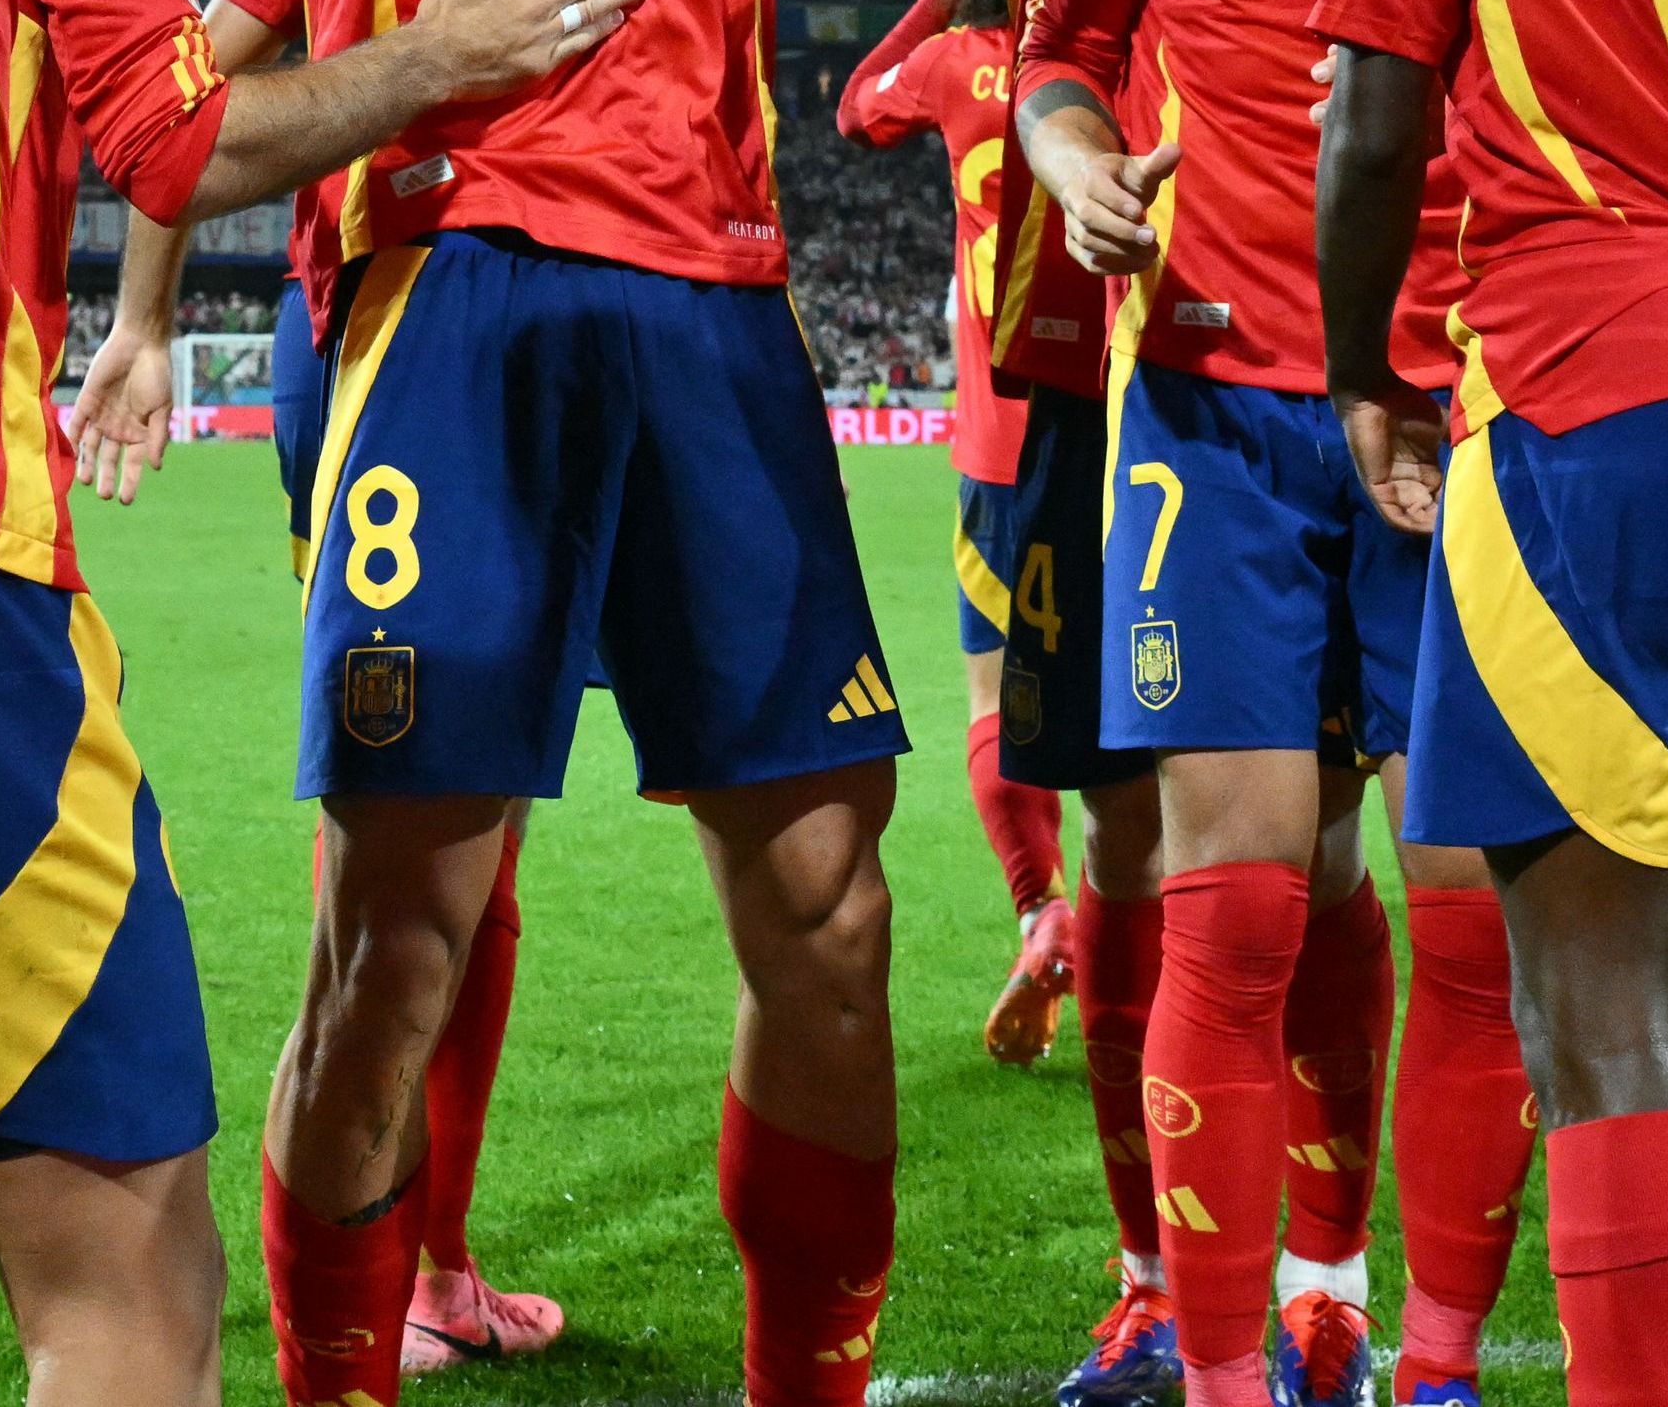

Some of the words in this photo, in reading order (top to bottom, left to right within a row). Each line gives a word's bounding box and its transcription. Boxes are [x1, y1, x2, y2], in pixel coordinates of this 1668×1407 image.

[728, 220, 775, 240] HEAT.RDY
[345, 465, 420, 610] 8
[1129, 461, 1184, 592] 7
[1016, 543, 1062, 654] 4
